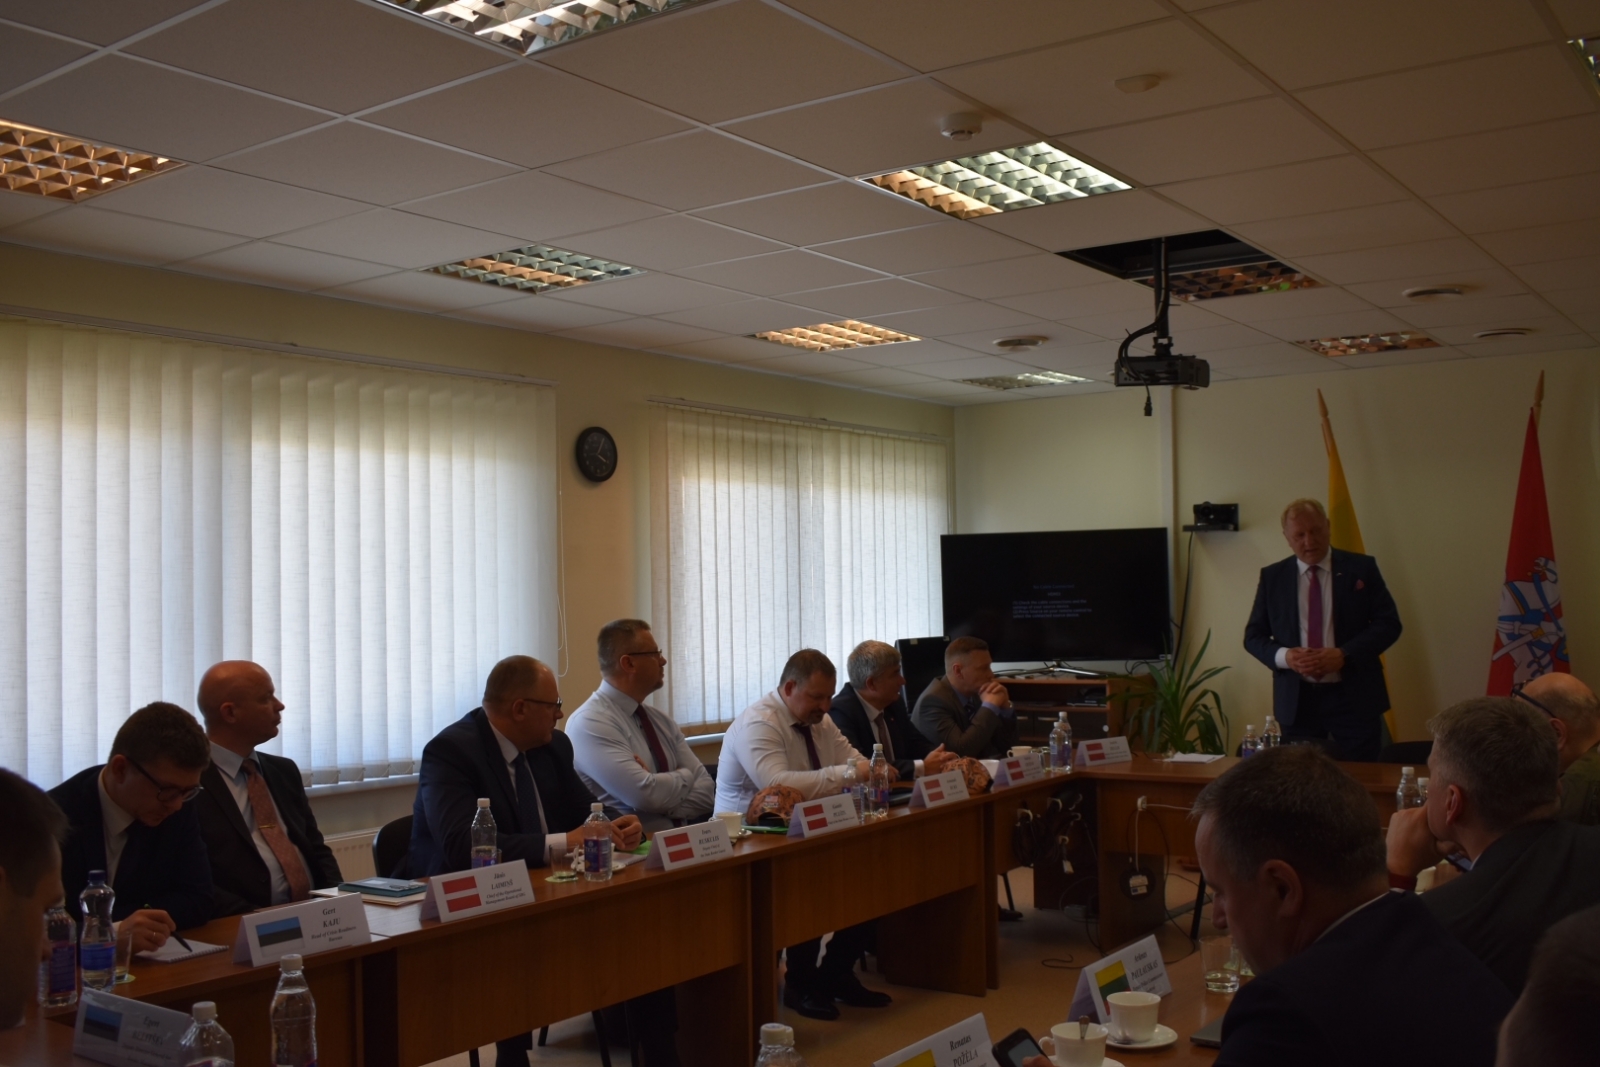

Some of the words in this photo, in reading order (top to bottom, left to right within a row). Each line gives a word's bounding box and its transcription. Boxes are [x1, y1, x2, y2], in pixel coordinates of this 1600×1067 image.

[322, 907, 336, 916] Gert
[323, 917, 341, 928] KAJU
[949, 1035, 972, 1051] Renatas
[953, 1048, 979, 1067] POŽĖLA
